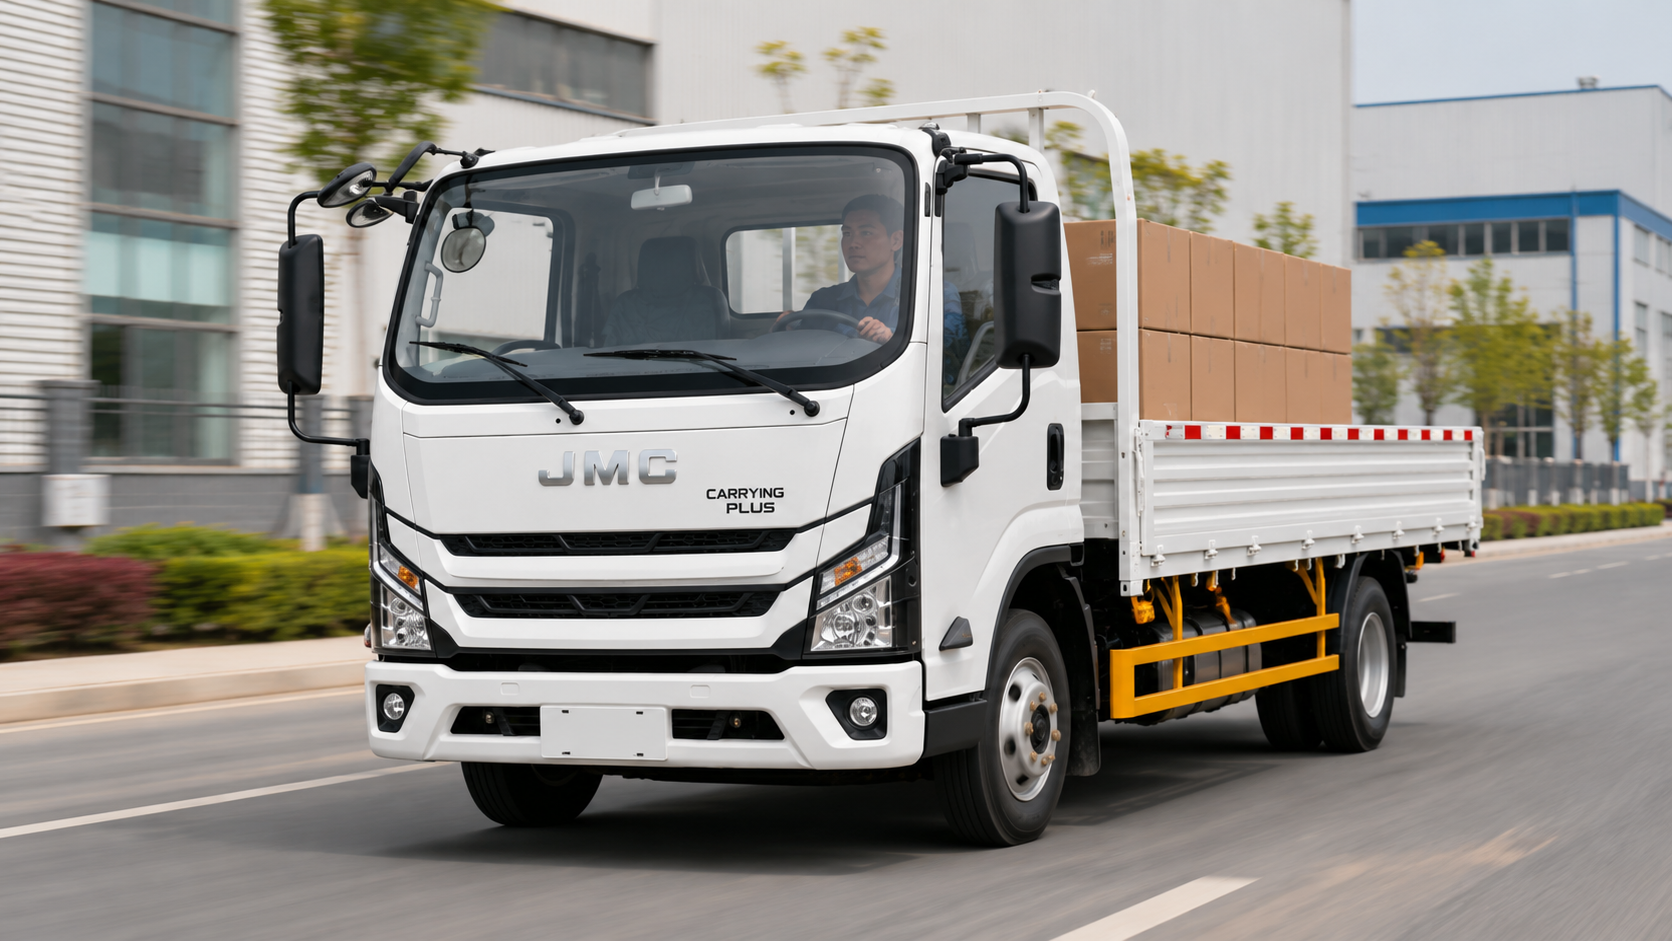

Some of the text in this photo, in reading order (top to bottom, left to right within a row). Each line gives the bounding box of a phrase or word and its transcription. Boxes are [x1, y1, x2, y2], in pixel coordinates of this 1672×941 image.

[538, 449, 677, 487] JMC
[706, 487, 784, 500] CARRYING
[726, 502, 775, 514] PLUS
